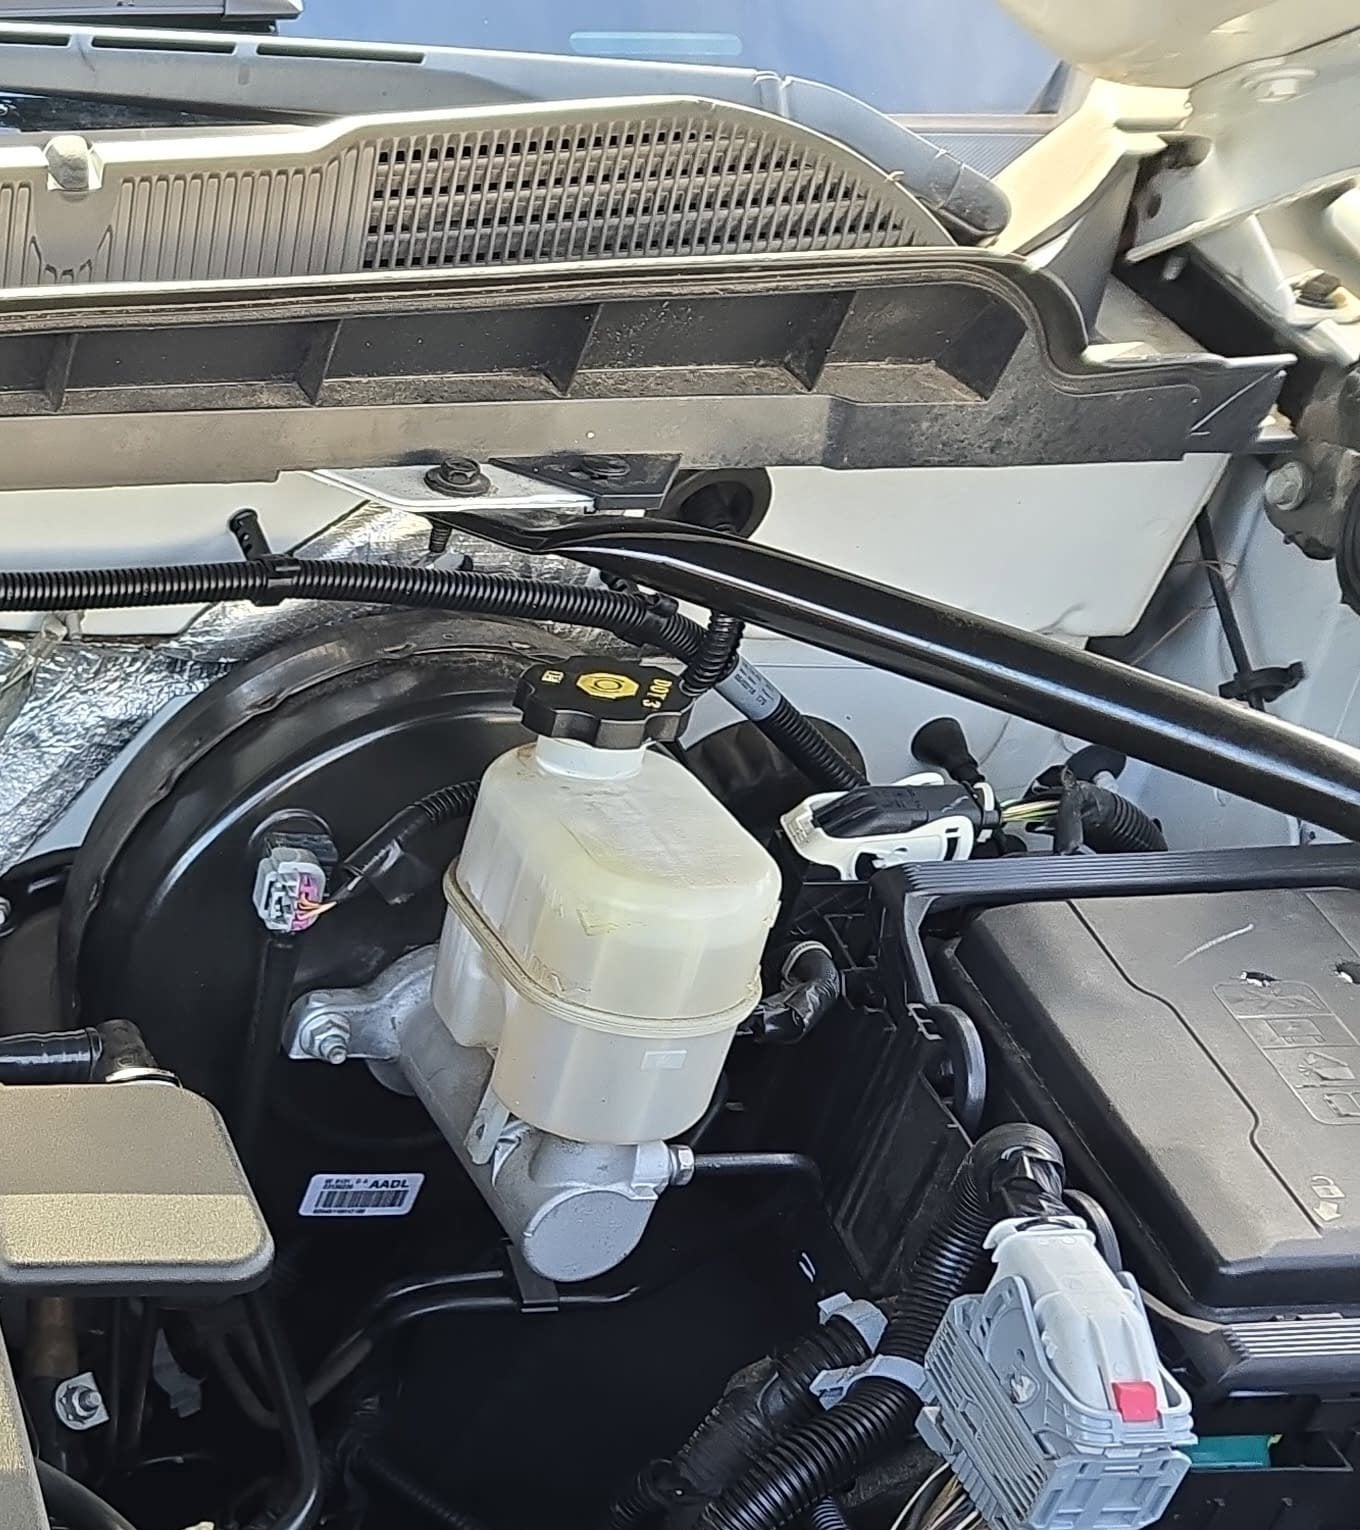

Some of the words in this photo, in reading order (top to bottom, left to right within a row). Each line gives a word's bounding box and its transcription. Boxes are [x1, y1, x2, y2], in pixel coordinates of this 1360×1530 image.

[649, 678, 673, 700] DOT
[642, 699, 662, 710] 3
[369, 1179, 410, 1189] AADL
